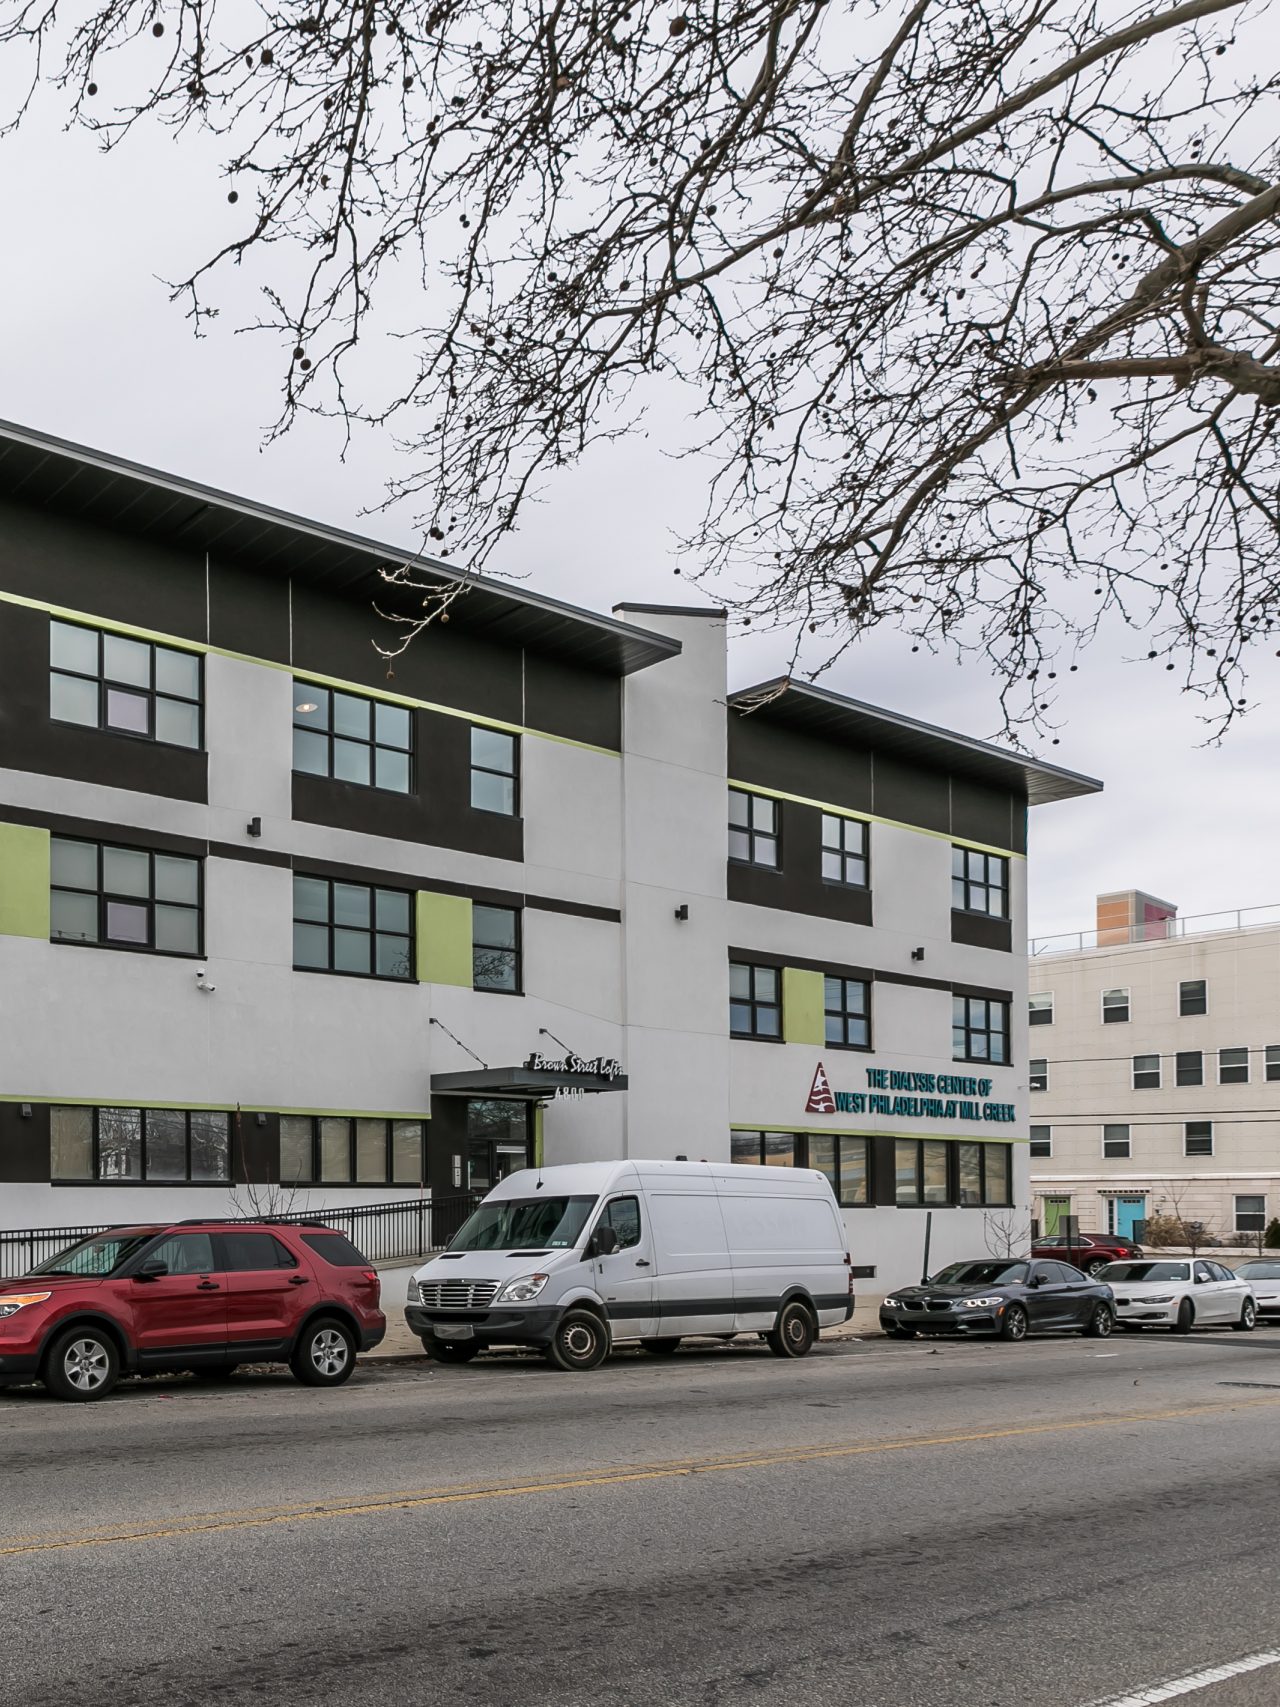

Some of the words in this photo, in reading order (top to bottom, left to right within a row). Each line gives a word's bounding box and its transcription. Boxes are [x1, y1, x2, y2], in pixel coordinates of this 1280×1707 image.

[532, 1052, 567, 1072] Brown
[569, 1054, 598, 1074] Street
[599, 1057, 624, 1081] Lofts
[554, 1086, 585, 1101] 4800
[865, 1068, 889, 1089] THE
[890, 1070, 936, 1093] DIALYSIS
[937, 1074, 977, 1096] CENTER
[978, 1078, 993, 1096] OF
[834, 1091, 868, 1113] WEST
[869, 1094, 944, 1118] PHILADELPHIA
[944, 1100, 959, 1118] AT
[959, 1101, 982, 1120] MILL
[983, 1102, 1016, 1122] CREEK
